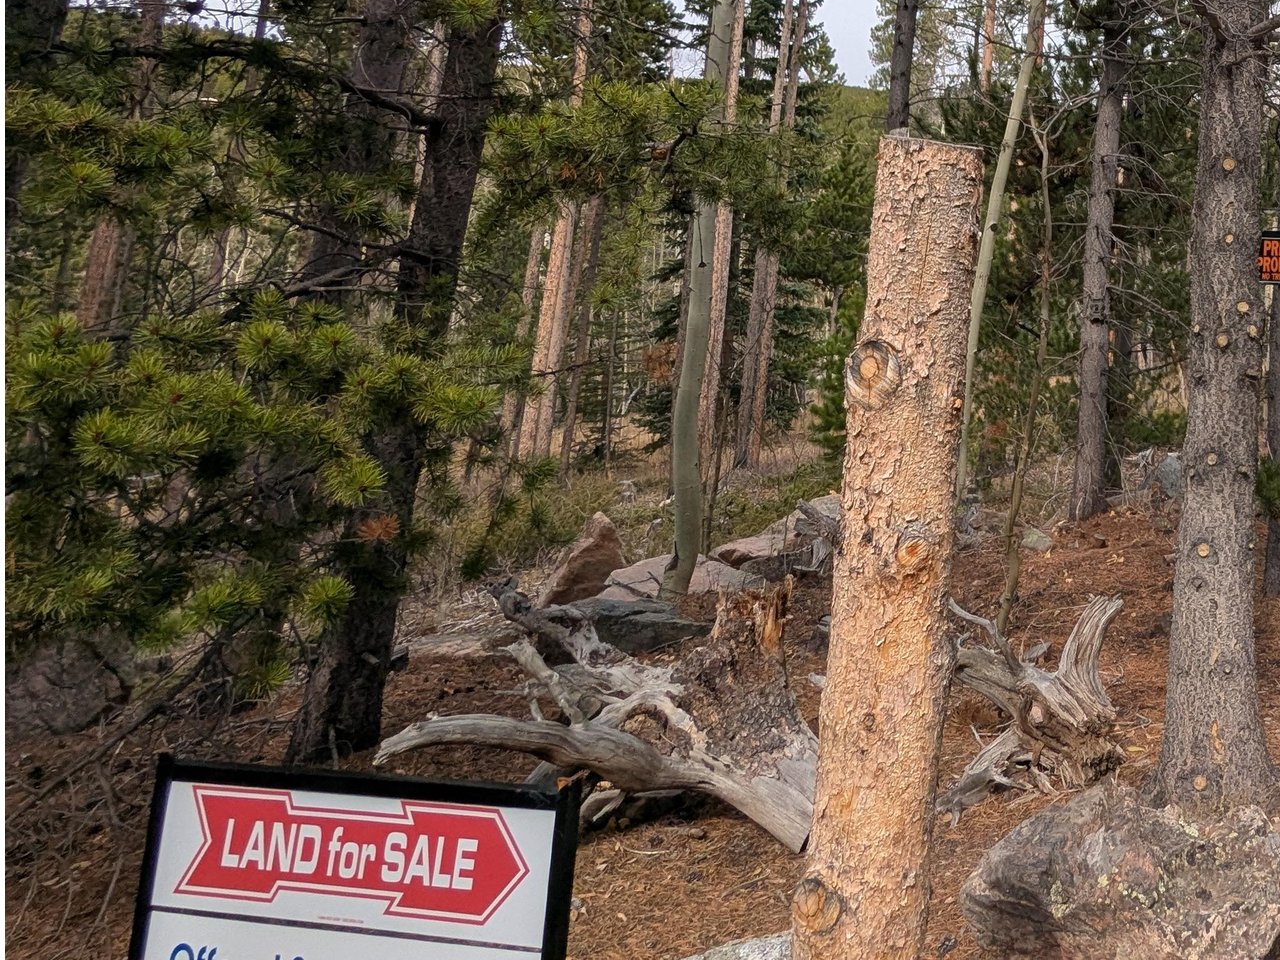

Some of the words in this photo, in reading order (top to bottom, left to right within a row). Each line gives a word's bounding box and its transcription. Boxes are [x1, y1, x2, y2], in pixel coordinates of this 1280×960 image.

[220, 817, 323, 875] LAND
[327, 826, 376, 880] for
[381, 831, 479, 891] SALE
